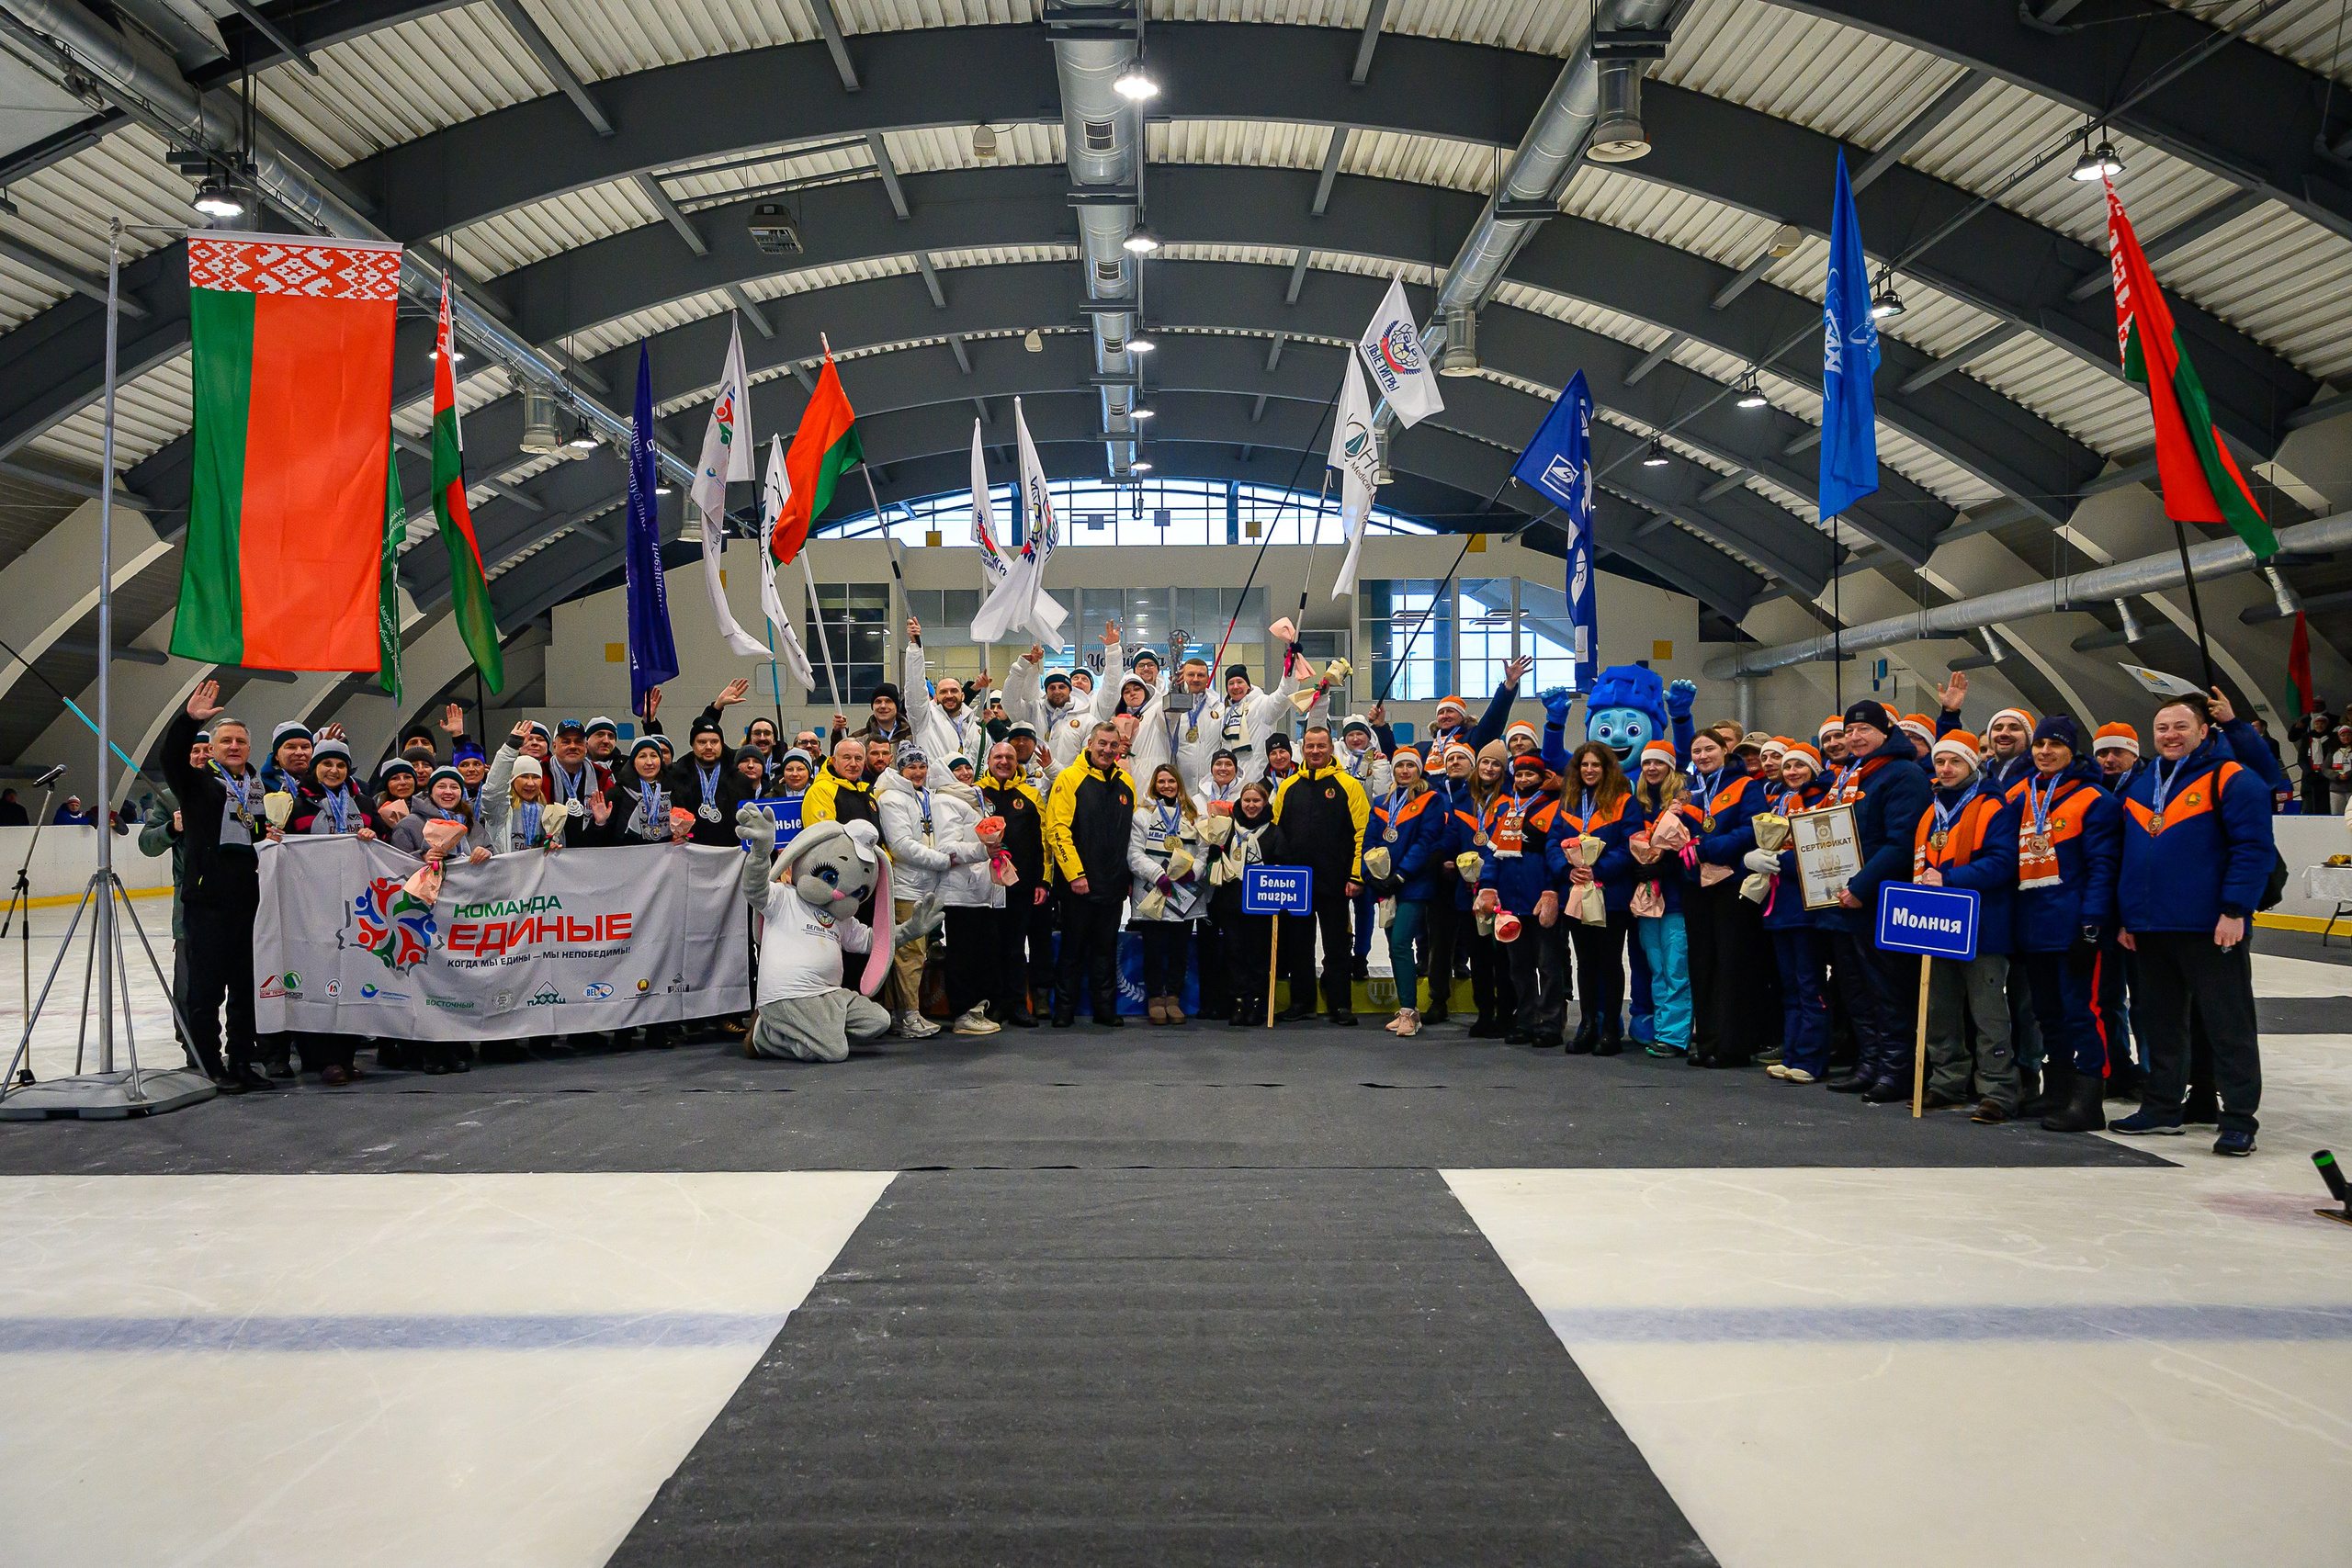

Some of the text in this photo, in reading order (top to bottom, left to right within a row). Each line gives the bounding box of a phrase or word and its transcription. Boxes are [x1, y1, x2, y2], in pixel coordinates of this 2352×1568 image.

[1366, 344, 1400, 391] ЛЫЕ ТИГРЫ
[775, 818, 802, 830] ные
[1055, 832, 1069, 863] BELARUS
[1801, 837, 1852, 853] СЕРТИФИКАТ
[1260, 874, 1296, 888] Белые
[454, 896, 562, 919] КОМАНДА
[1257, 892, 1297, 906] тигры
[806, 923, 826, 932] БЕЛЫЕ
[1893, 907, 1962, 934] Молния
[447, 913, 632, 957] ЕДИНЫЕ
[447, 959, 478, 969] КОГДА
[481, 958, 498, 966] МЫ
[501, 954, 531, 965] ЕДИНЫ
[542, 951, 560, 959] МЫ
[561, 946, 631, 959] НЕПОБЕДИМЫ!
[425, 998, 475, 1009] ВОСТОЧНЫЙ
